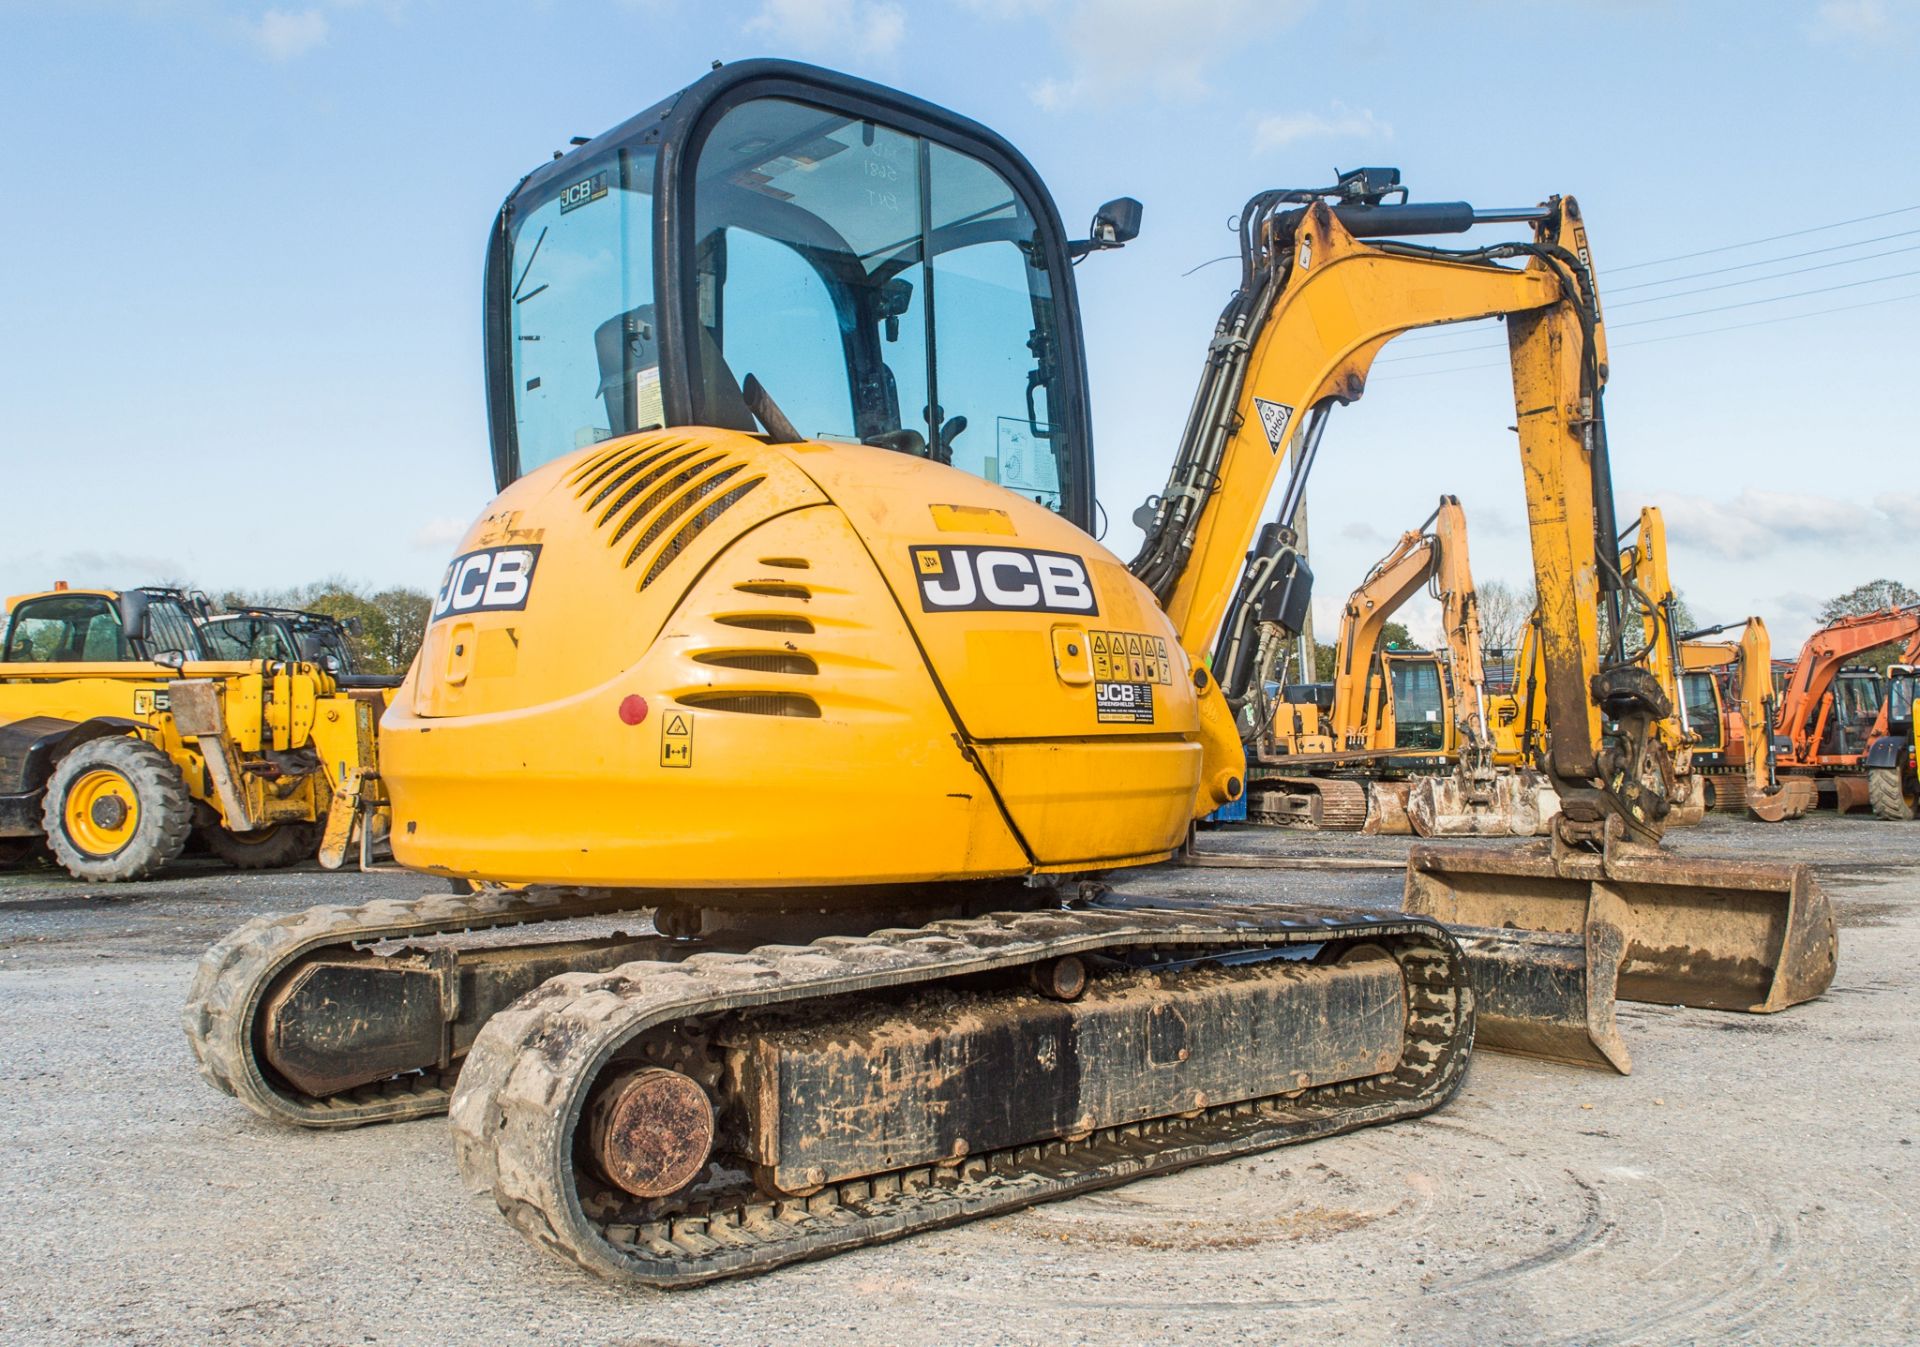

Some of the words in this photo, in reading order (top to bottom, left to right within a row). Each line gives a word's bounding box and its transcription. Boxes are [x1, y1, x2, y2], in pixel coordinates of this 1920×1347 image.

[561, 180, 591, 207] JCB
[435, 550, 534, 616] JCB
[923, 550, 1093, 610] JCB
[1097, 684, 1134, 701] JCB
